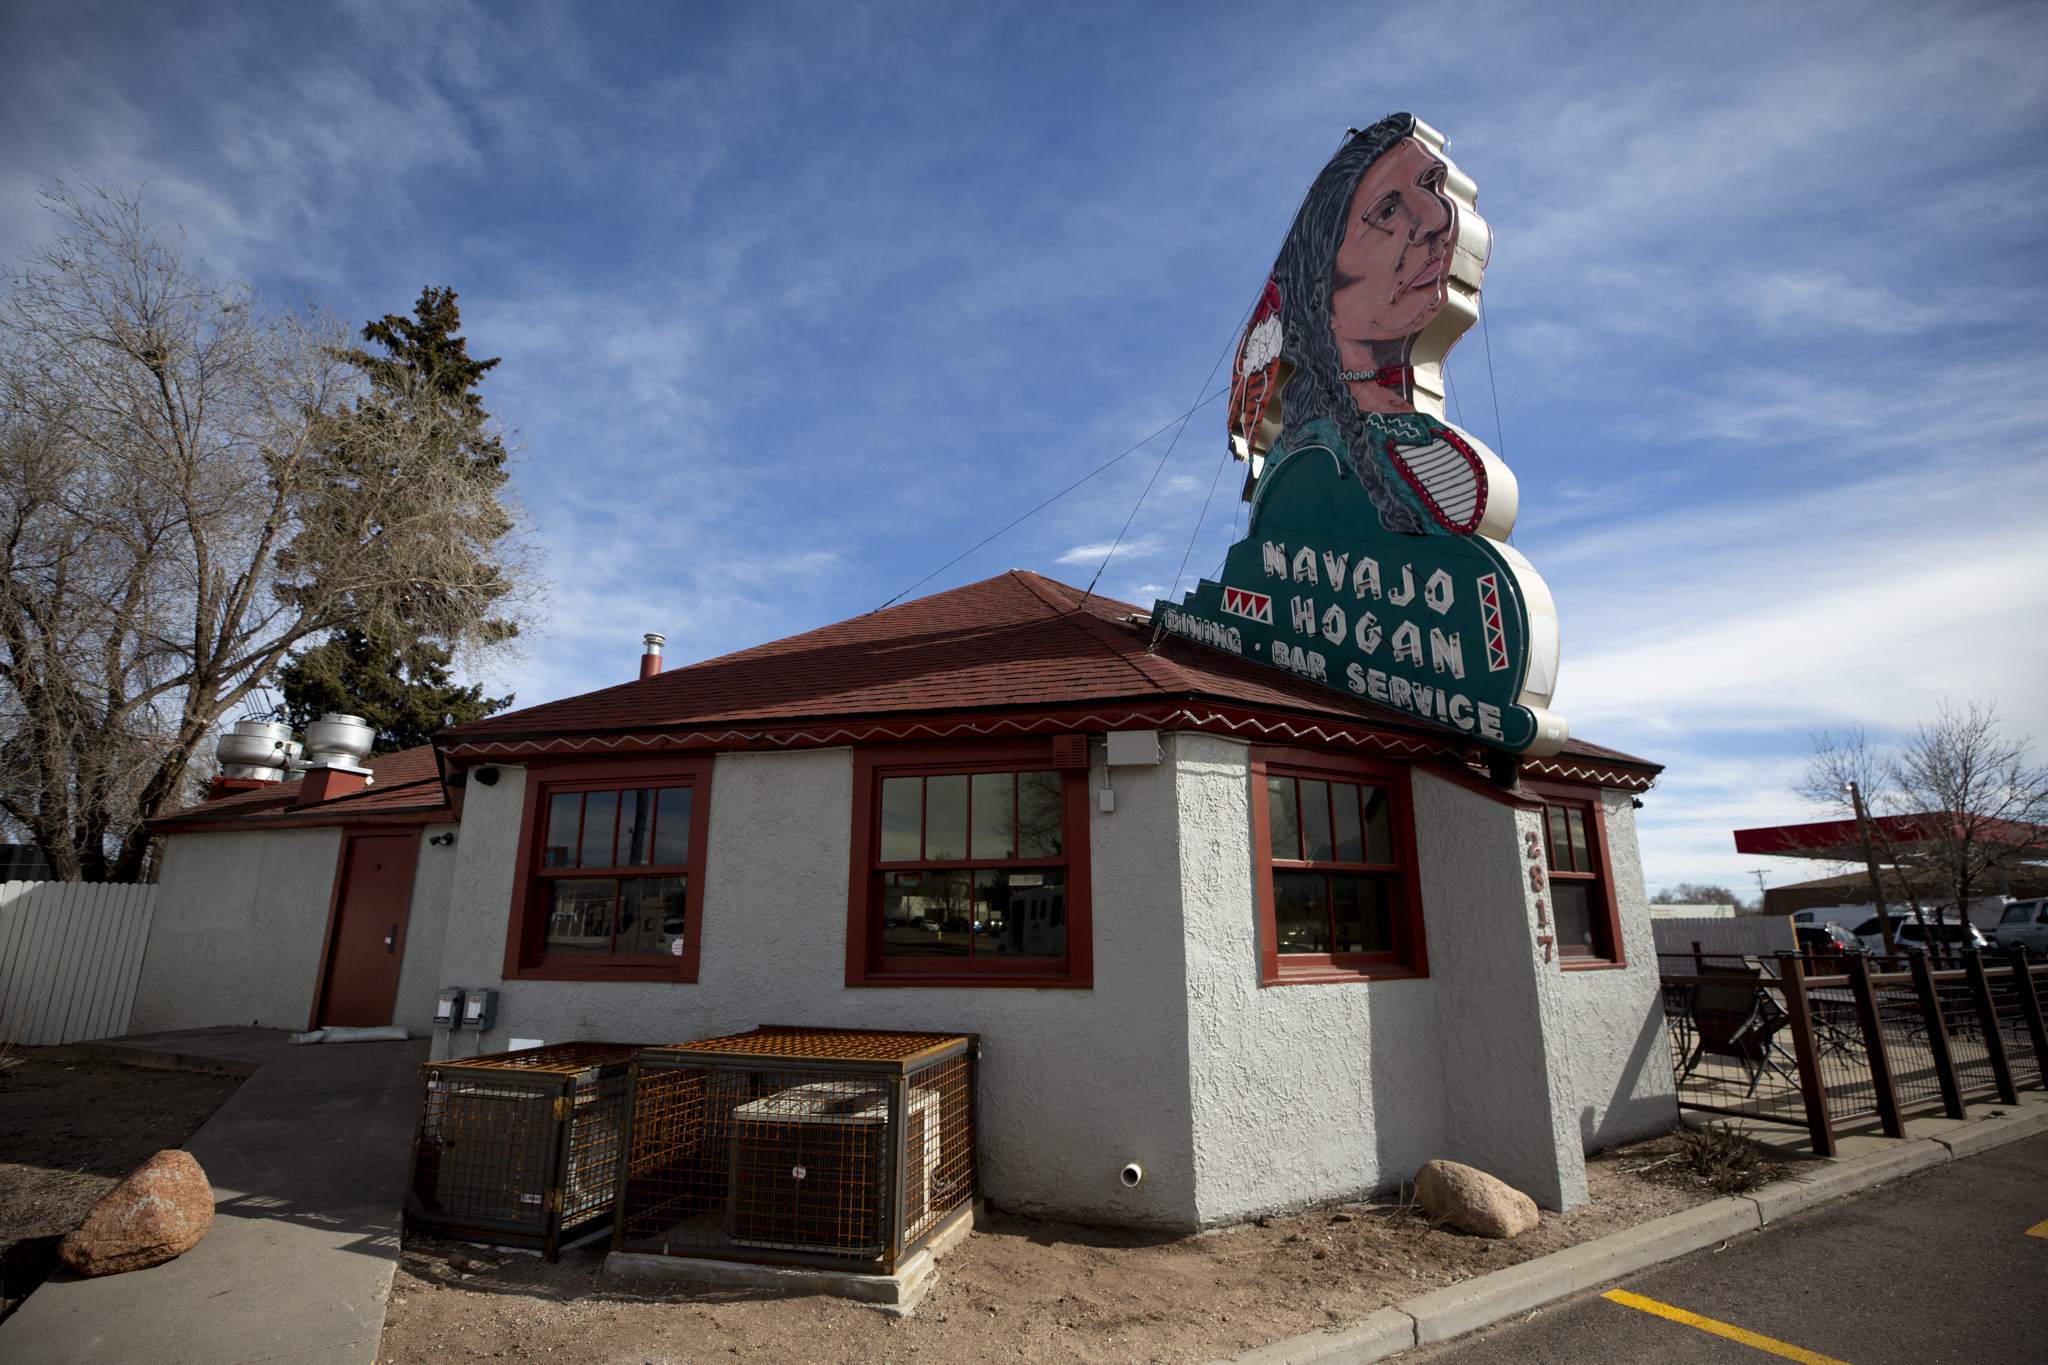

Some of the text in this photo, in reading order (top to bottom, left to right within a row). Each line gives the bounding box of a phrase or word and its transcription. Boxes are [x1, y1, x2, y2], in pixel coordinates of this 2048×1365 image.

[1263, 540, 1454, 615] NAVAJO
[1164, 609, 1504, 741] DINING BAR SERVICE
[1291, 594, 1465, 679] HOGAN
[1526, 831, 1554, 964] 2817
